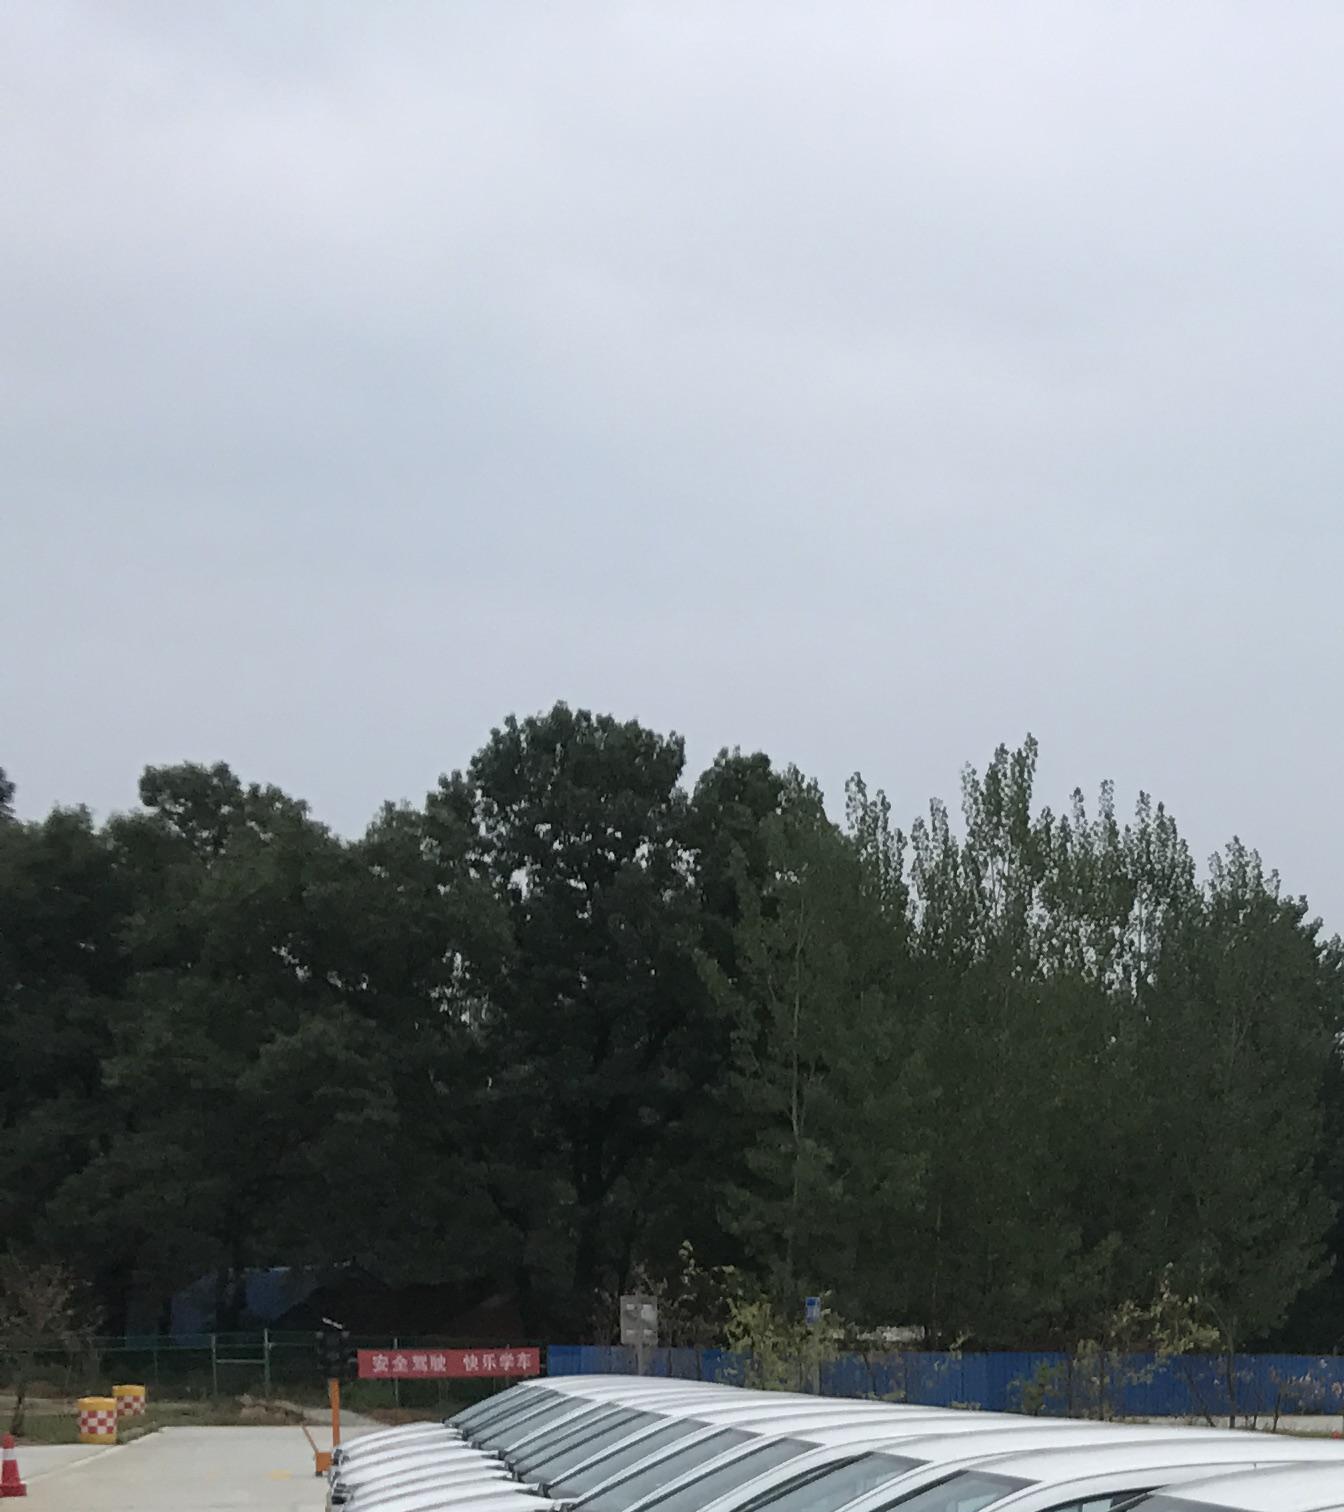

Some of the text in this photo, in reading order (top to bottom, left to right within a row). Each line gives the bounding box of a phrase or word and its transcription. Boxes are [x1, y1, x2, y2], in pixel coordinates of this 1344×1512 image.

[372, 1351, 532, 1373] 安全驾驶 快乐学车
